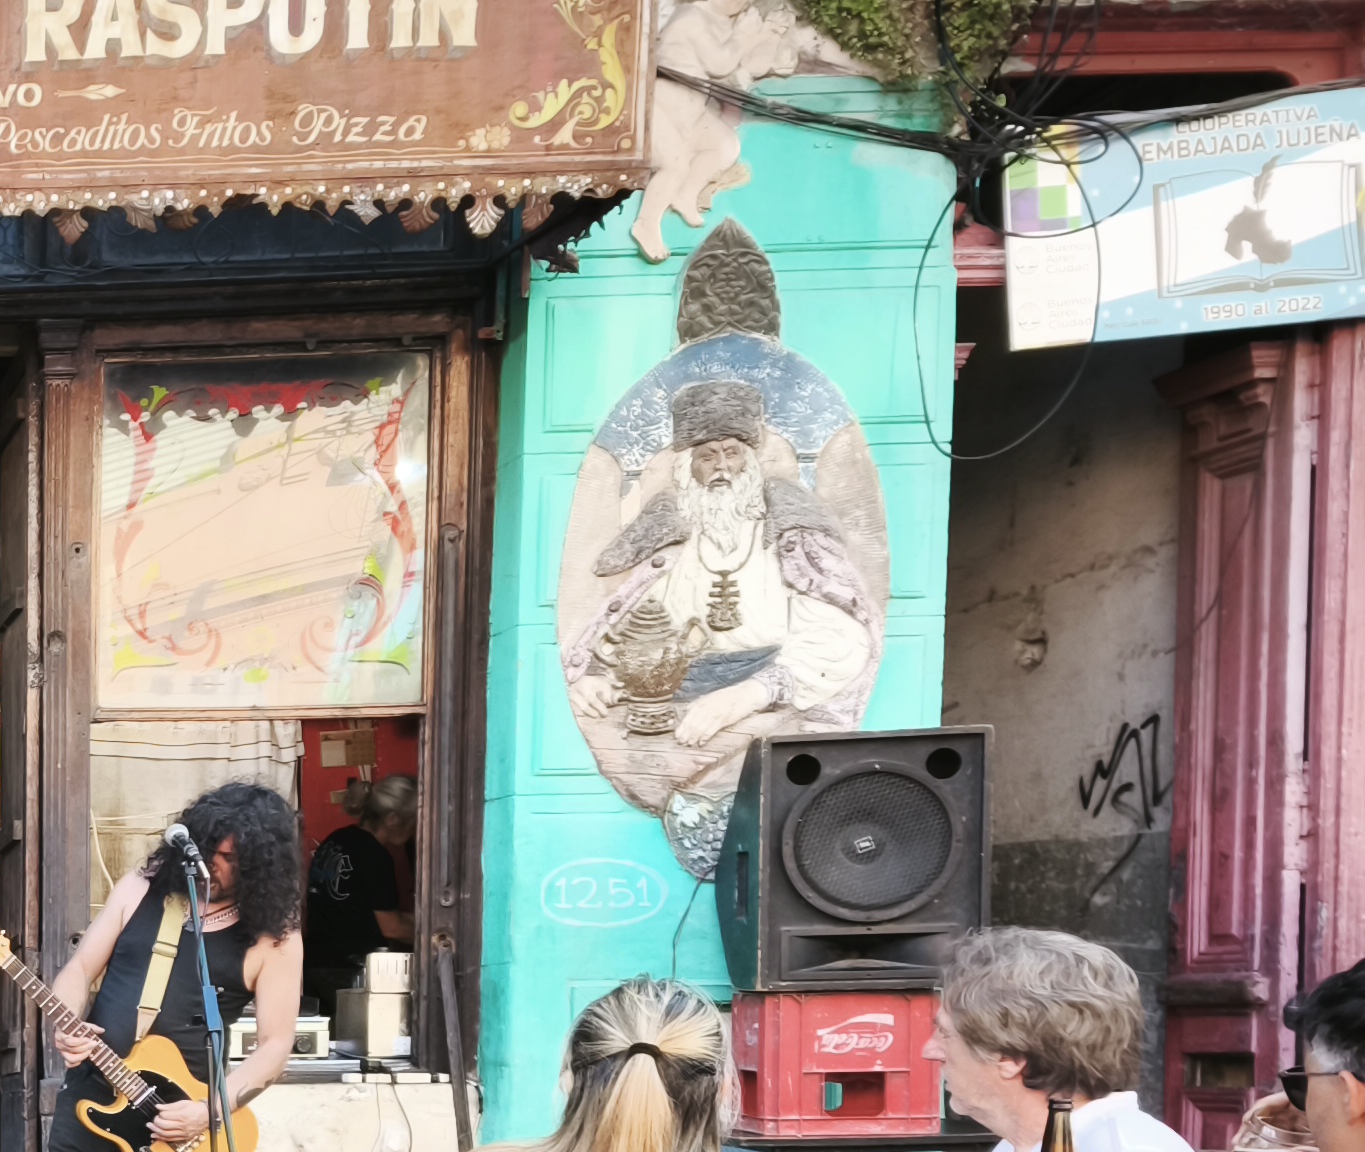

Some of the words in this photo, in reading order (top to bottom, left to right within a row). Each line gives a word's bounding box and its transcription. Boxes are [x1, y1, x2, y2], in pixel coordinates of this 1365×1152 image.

[167, 105, 273, 149] Fritos
[293, 102, 427, 144] Pizza
[1175, 106, 1320, 135] COOPERATIVA
[1141, 132, 1269, 163] EMBAJADA
[1274, 117, 1362, 149] JUJEÑA
[1203, 302, 1247, 321] 1990
[1252, 301, 1270, 317] al
[1276, 296, 1323, 314] 2022
[553, 877, 652, 910] 1251
